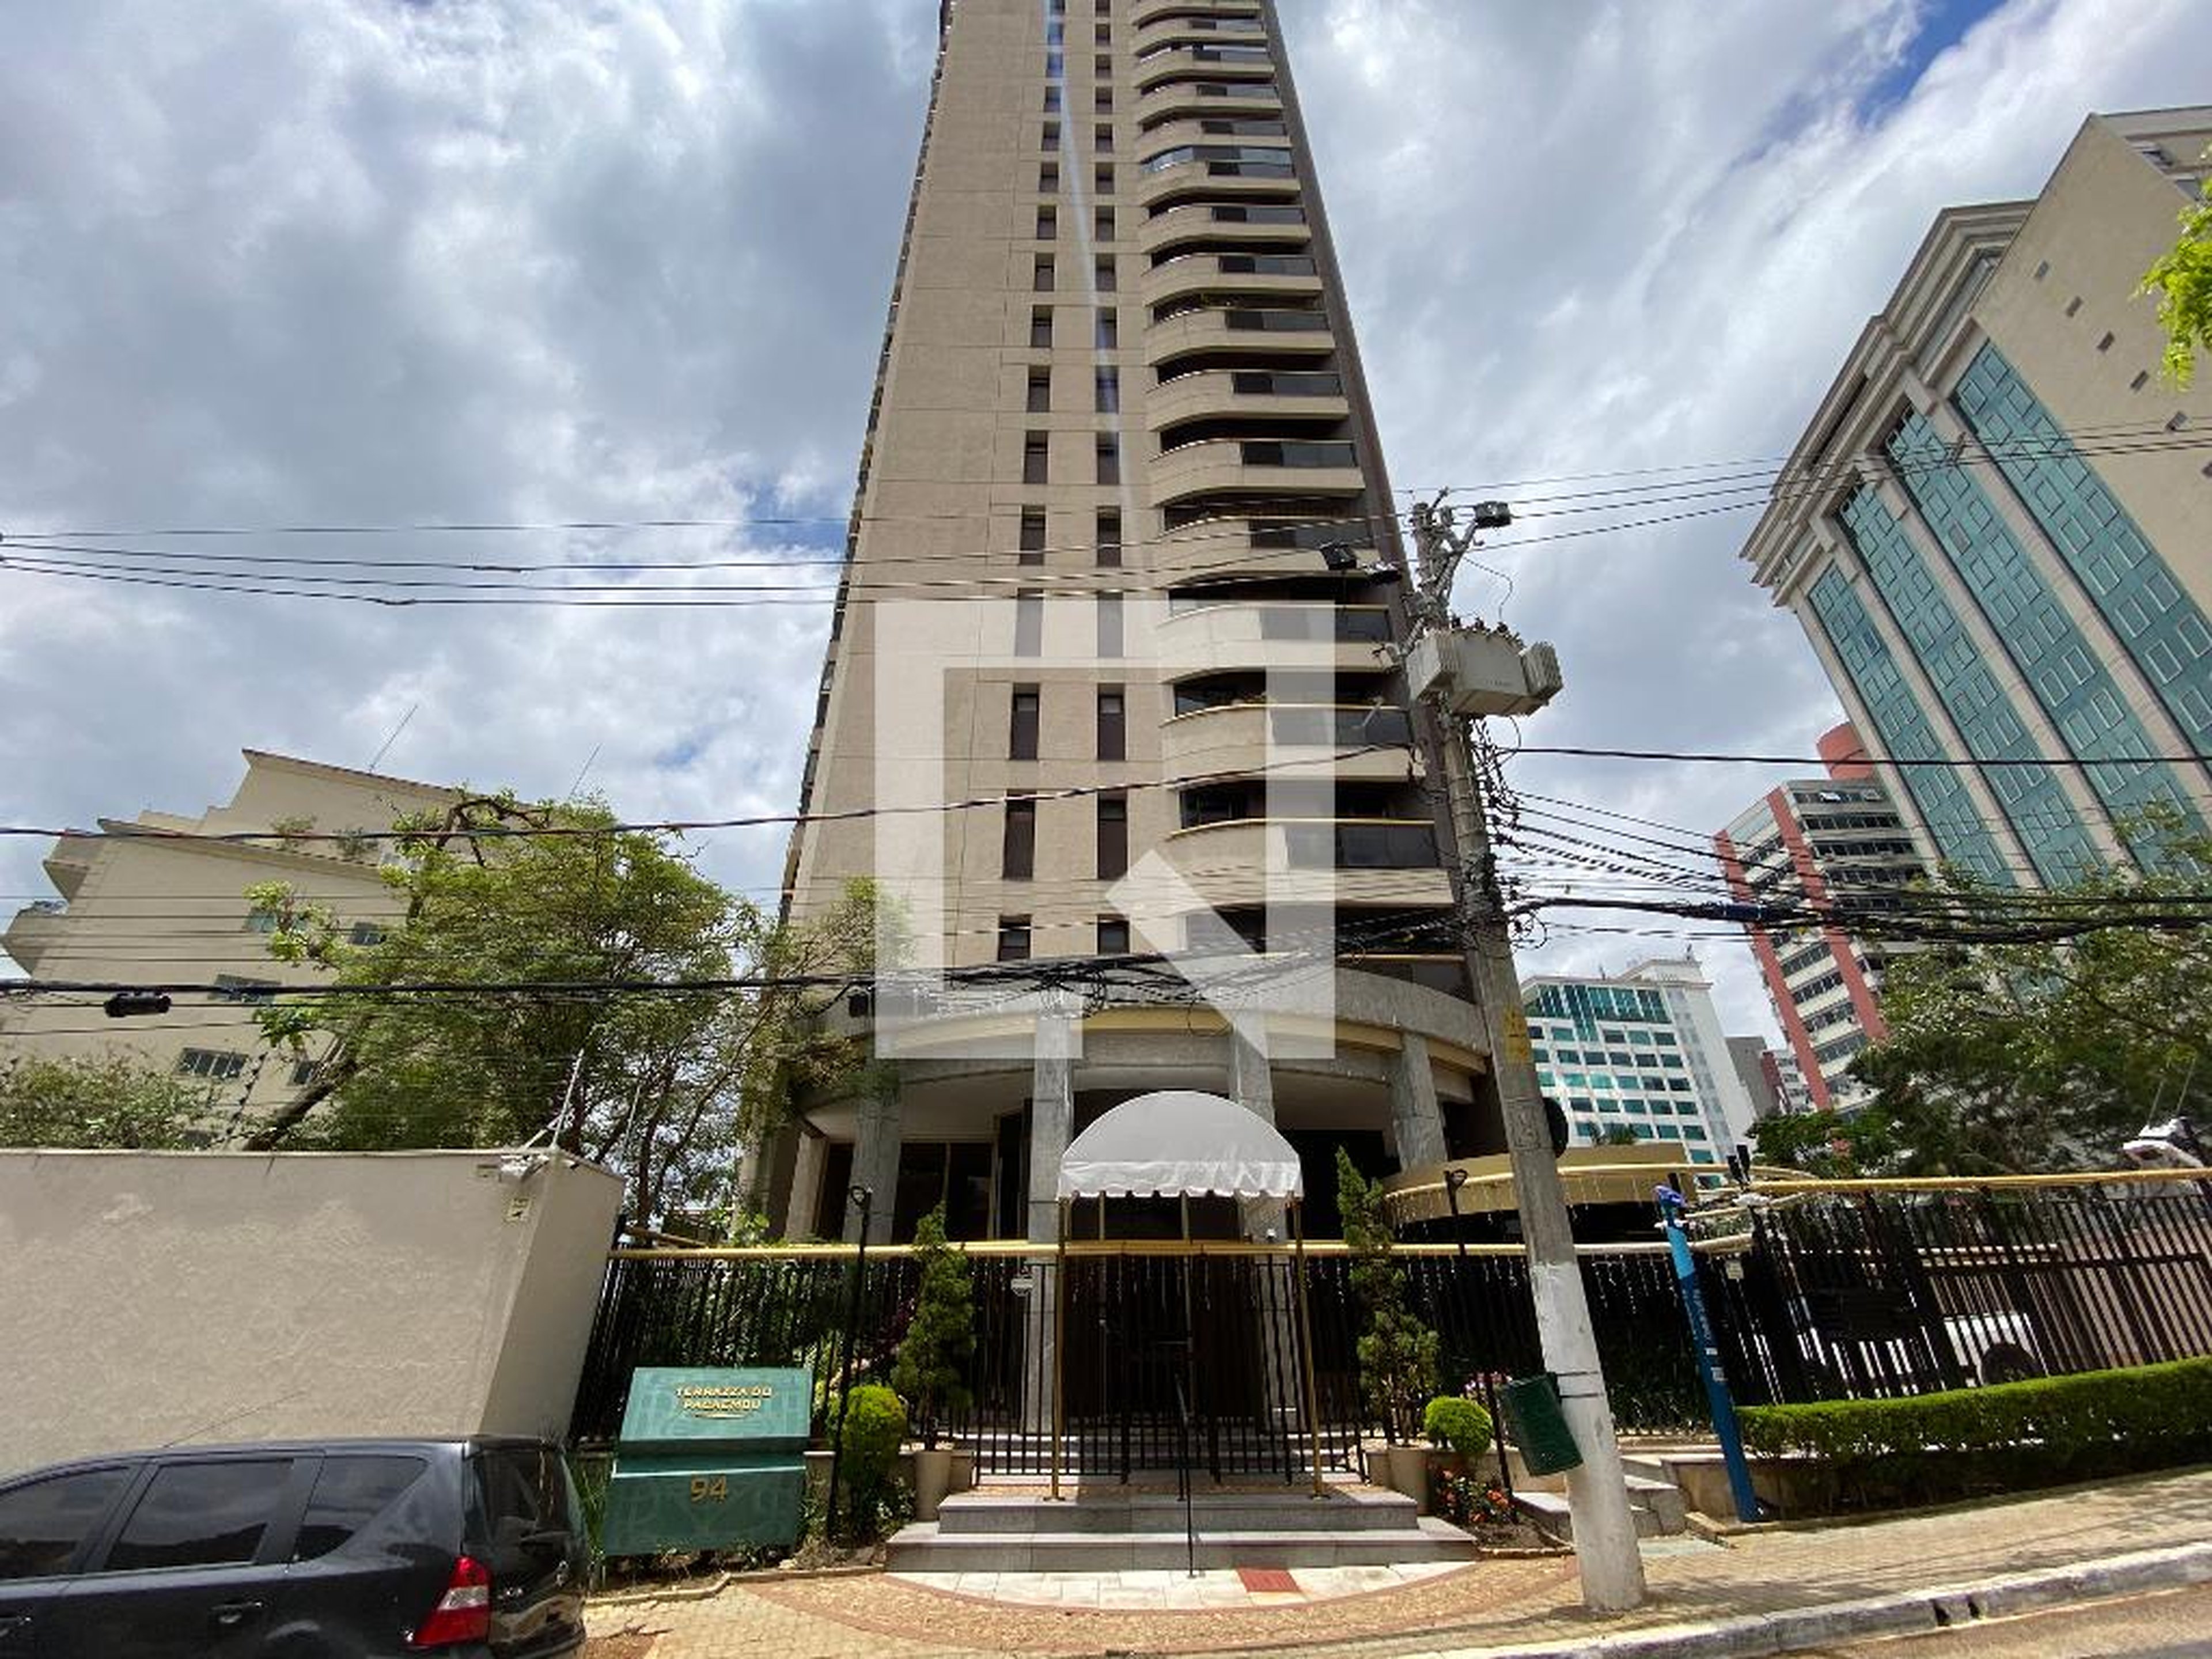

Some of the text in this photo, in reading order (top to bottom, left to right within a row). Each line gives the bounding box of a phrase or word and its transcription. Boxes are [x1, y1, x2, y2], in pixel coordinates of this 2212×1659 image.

[675, 1385, 772, 1396] TERRAZZA DO
[691, 1476, 726, 1502] 94
